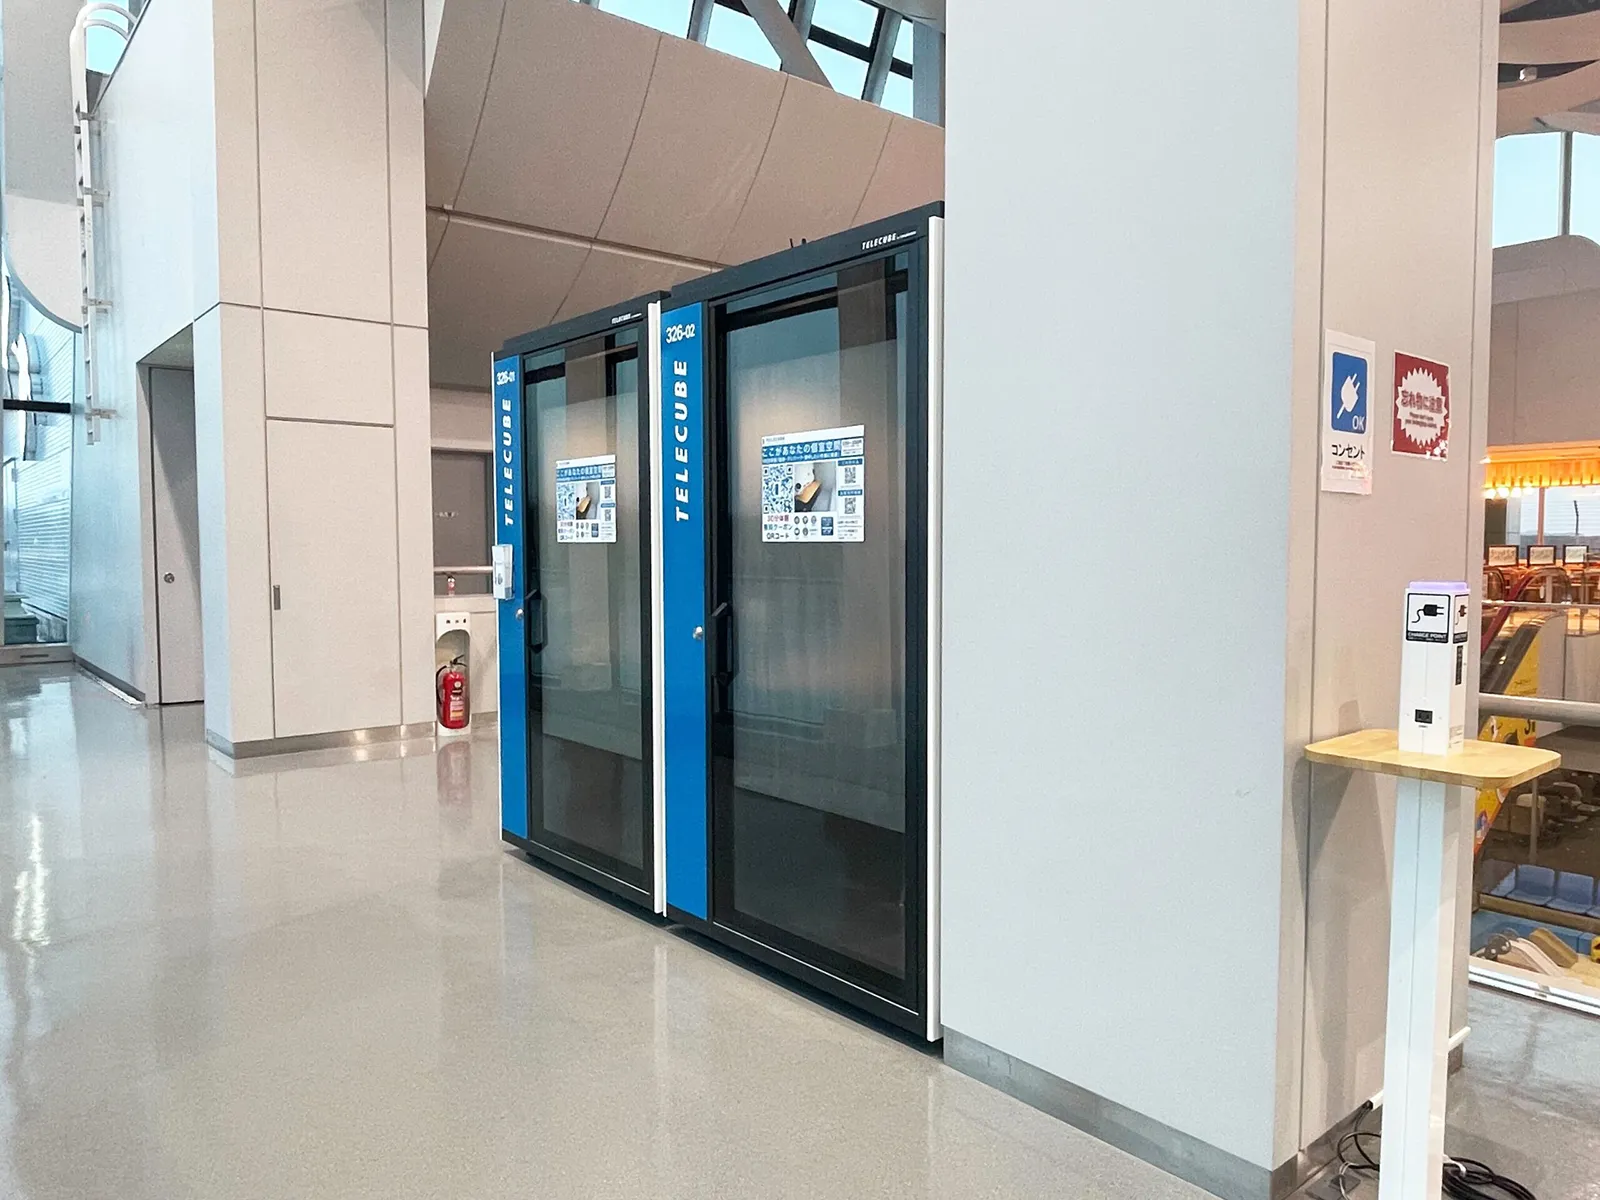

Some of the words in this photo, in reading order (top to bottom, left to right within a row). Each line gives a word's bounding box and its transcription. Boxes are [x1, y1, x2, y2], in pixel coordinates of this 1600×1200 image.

[862, 233, 896, 250] TELECUBE
[665, 323, 696, 344] 326-02
[1352, 415, 1365, 431] OK
[673, 360, 690, 522] TELECUBE
[1331, 443, 1366, 460] コンセント
[502, 399, 514, 526] TELECUBE
